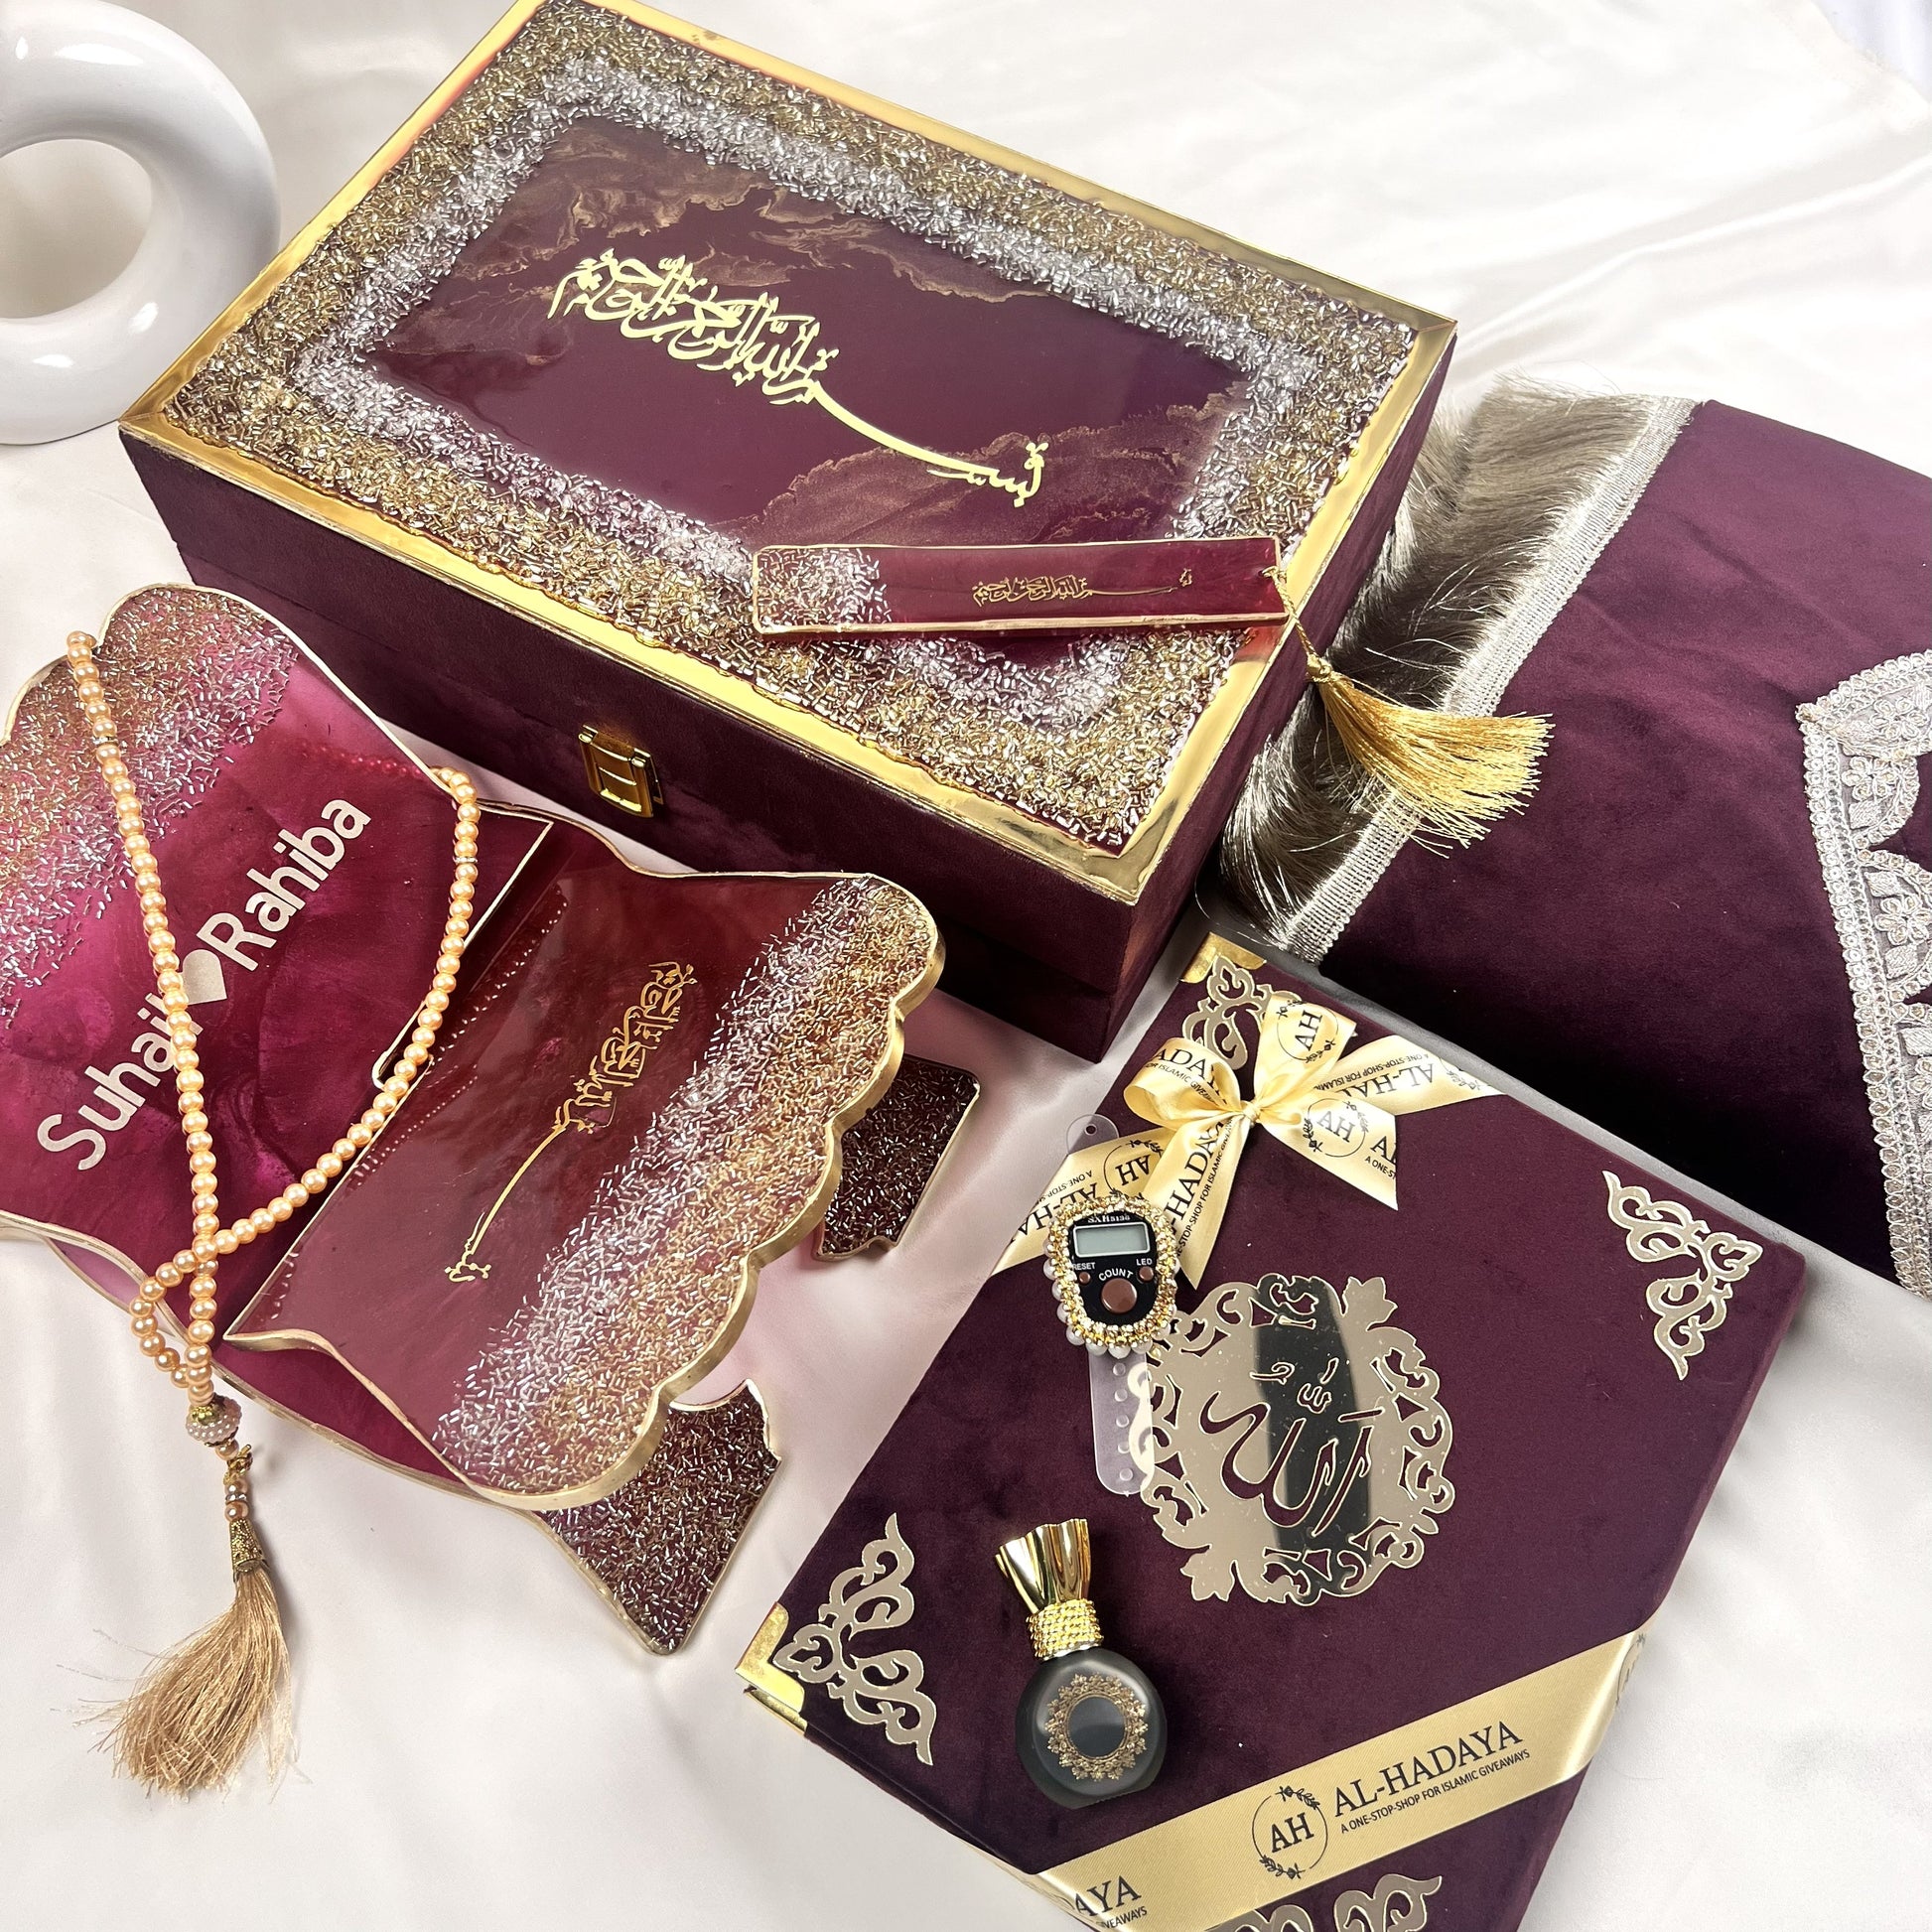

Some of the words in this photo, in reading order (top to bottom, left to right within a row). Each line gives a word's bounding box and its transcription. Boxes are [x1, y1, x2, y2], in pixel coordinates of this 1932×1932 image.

[196, 799, 372, 972] Rahiba
[1294, 1009, 1323, 1052] AH
[1158, 1064, 1192, 1082] ISLAMIC
[1345, 1071, 1362, 1083] FOR
[1362, 1053, 1423, 1077] ONE-STOP-SHOP
[1313, 1075, 1345, 1091] ISLAMI
[1316, 1110, 1356, 1143] AH
[1115, 1154, 1152, 1185] AH
[1200, 1184, 1211, 1202] FOR
[1206, 1152, 1223, 1184] ISLAMIC
[1073, 1262, 1096, 1271] RESET
[1098, 1268, 1134, 1282] COUNT
[1334, 1721, 1523, 1817] AL-HADAYA
[1340, 1823, 1349, 1834] A
[1348, 1794, 1421, 1831] ONE-STOP-SHOP
[1422, 1785, 1442, 1801] FOR
[1441, 1770, 1479, 1794] ISLAMIC
[1478, 1748, 1531, 1777] GIVEAWAYS
[1272, 1812, 1314, 1854] AH
